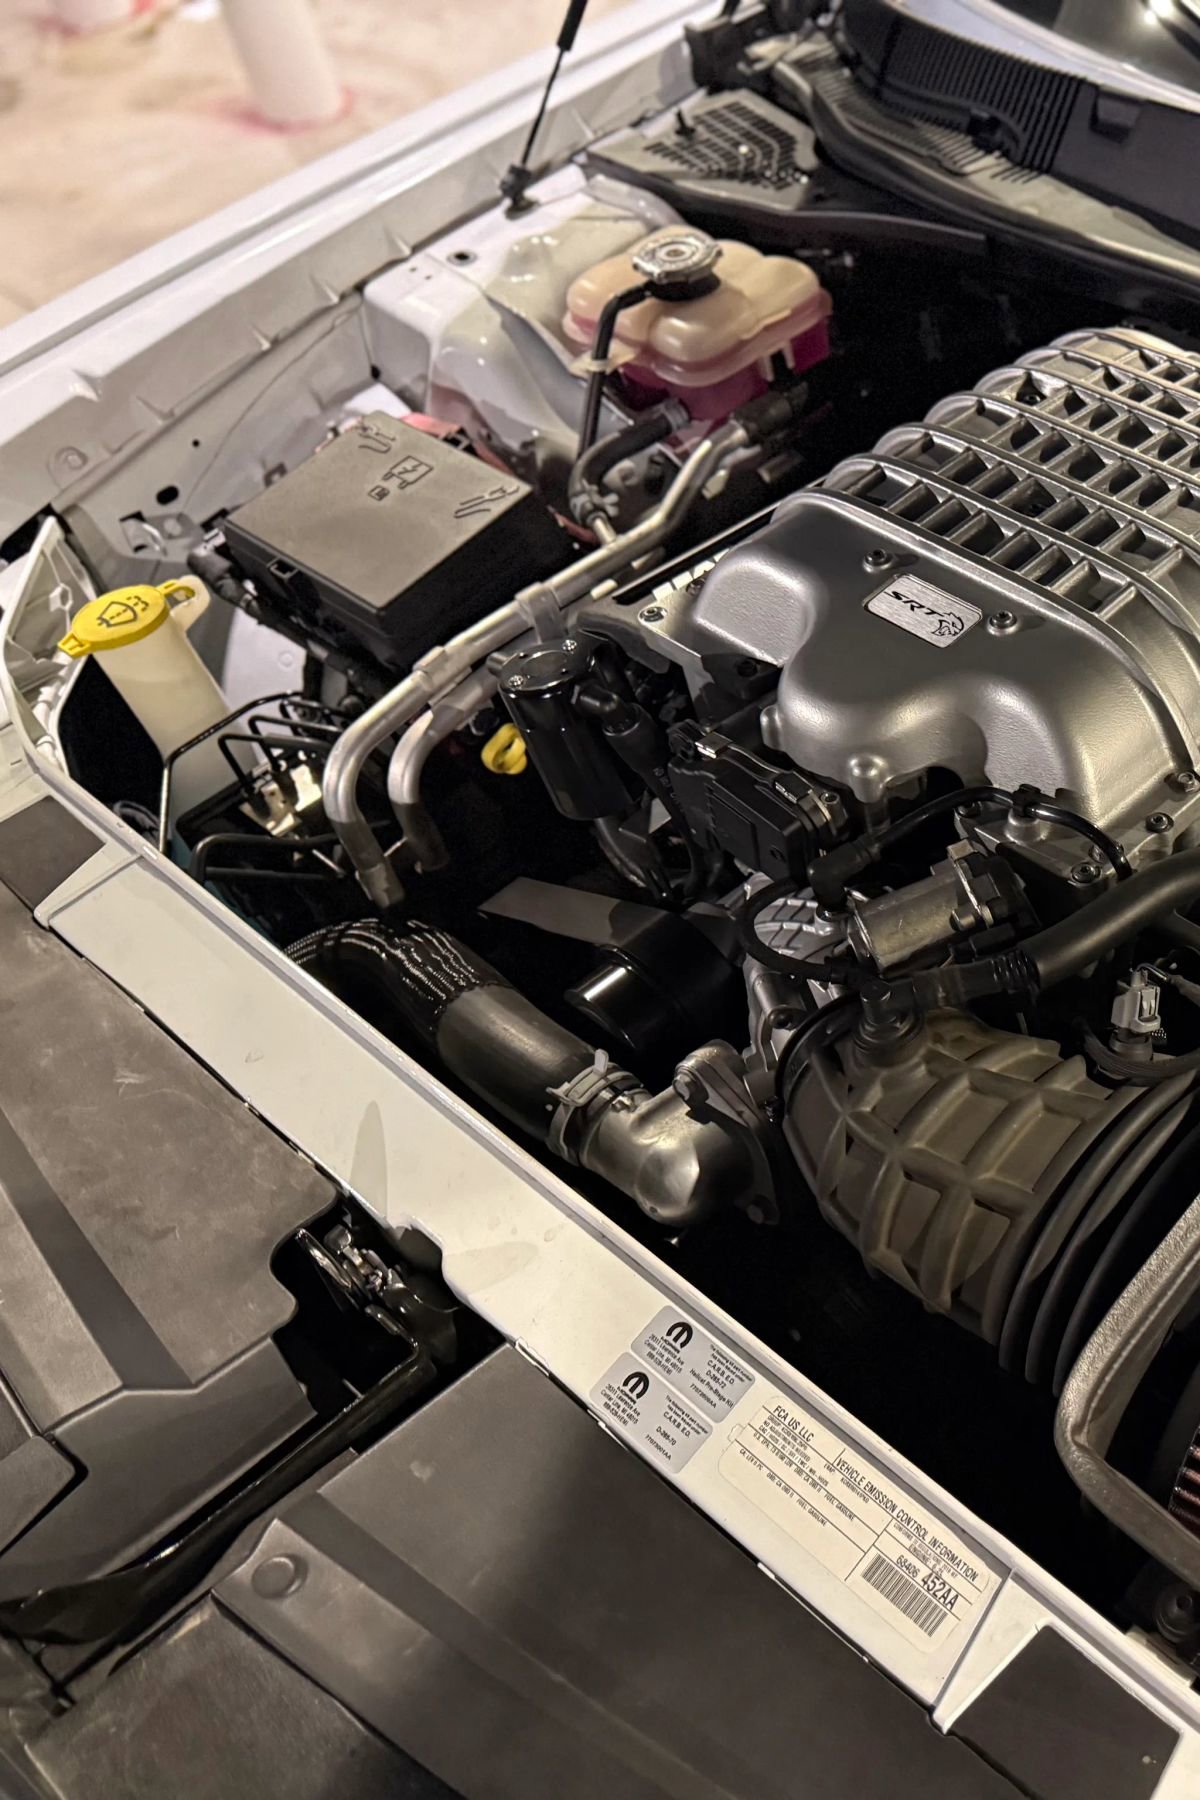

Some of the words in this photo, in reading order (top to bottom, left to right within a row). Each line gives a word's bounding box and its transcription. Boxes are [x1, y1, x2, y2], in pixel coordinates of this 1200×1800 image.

[884, 590, 944, 616] SRT
[600, 1389, 613, 1402] Center
[725, 1399, 733, 1408] Kit
[632, 1407, 640, 1417] Ave
[773, 1405, 788, 1421] FCA
[787, 1417, 800, 1430] US
[798, 1426, 814, 1442] LLC
[807, 1508, 827, 1526] GASOLINE
[835, 1502, 856, 1521] GASOLINE
[836, 1458, 865, 1485] VEHICLE
[863, 1481, 897, 1513] EMISSION
[896, 1509, 928, 1541] CONTROL
[928, 1536, 978, 1581] INFORMATION
[907, 1543, 930, 1566] ENGINE:
[896, 1554, 920, 1578] 68406
[919, 1572, 959, 1610] 452AA
